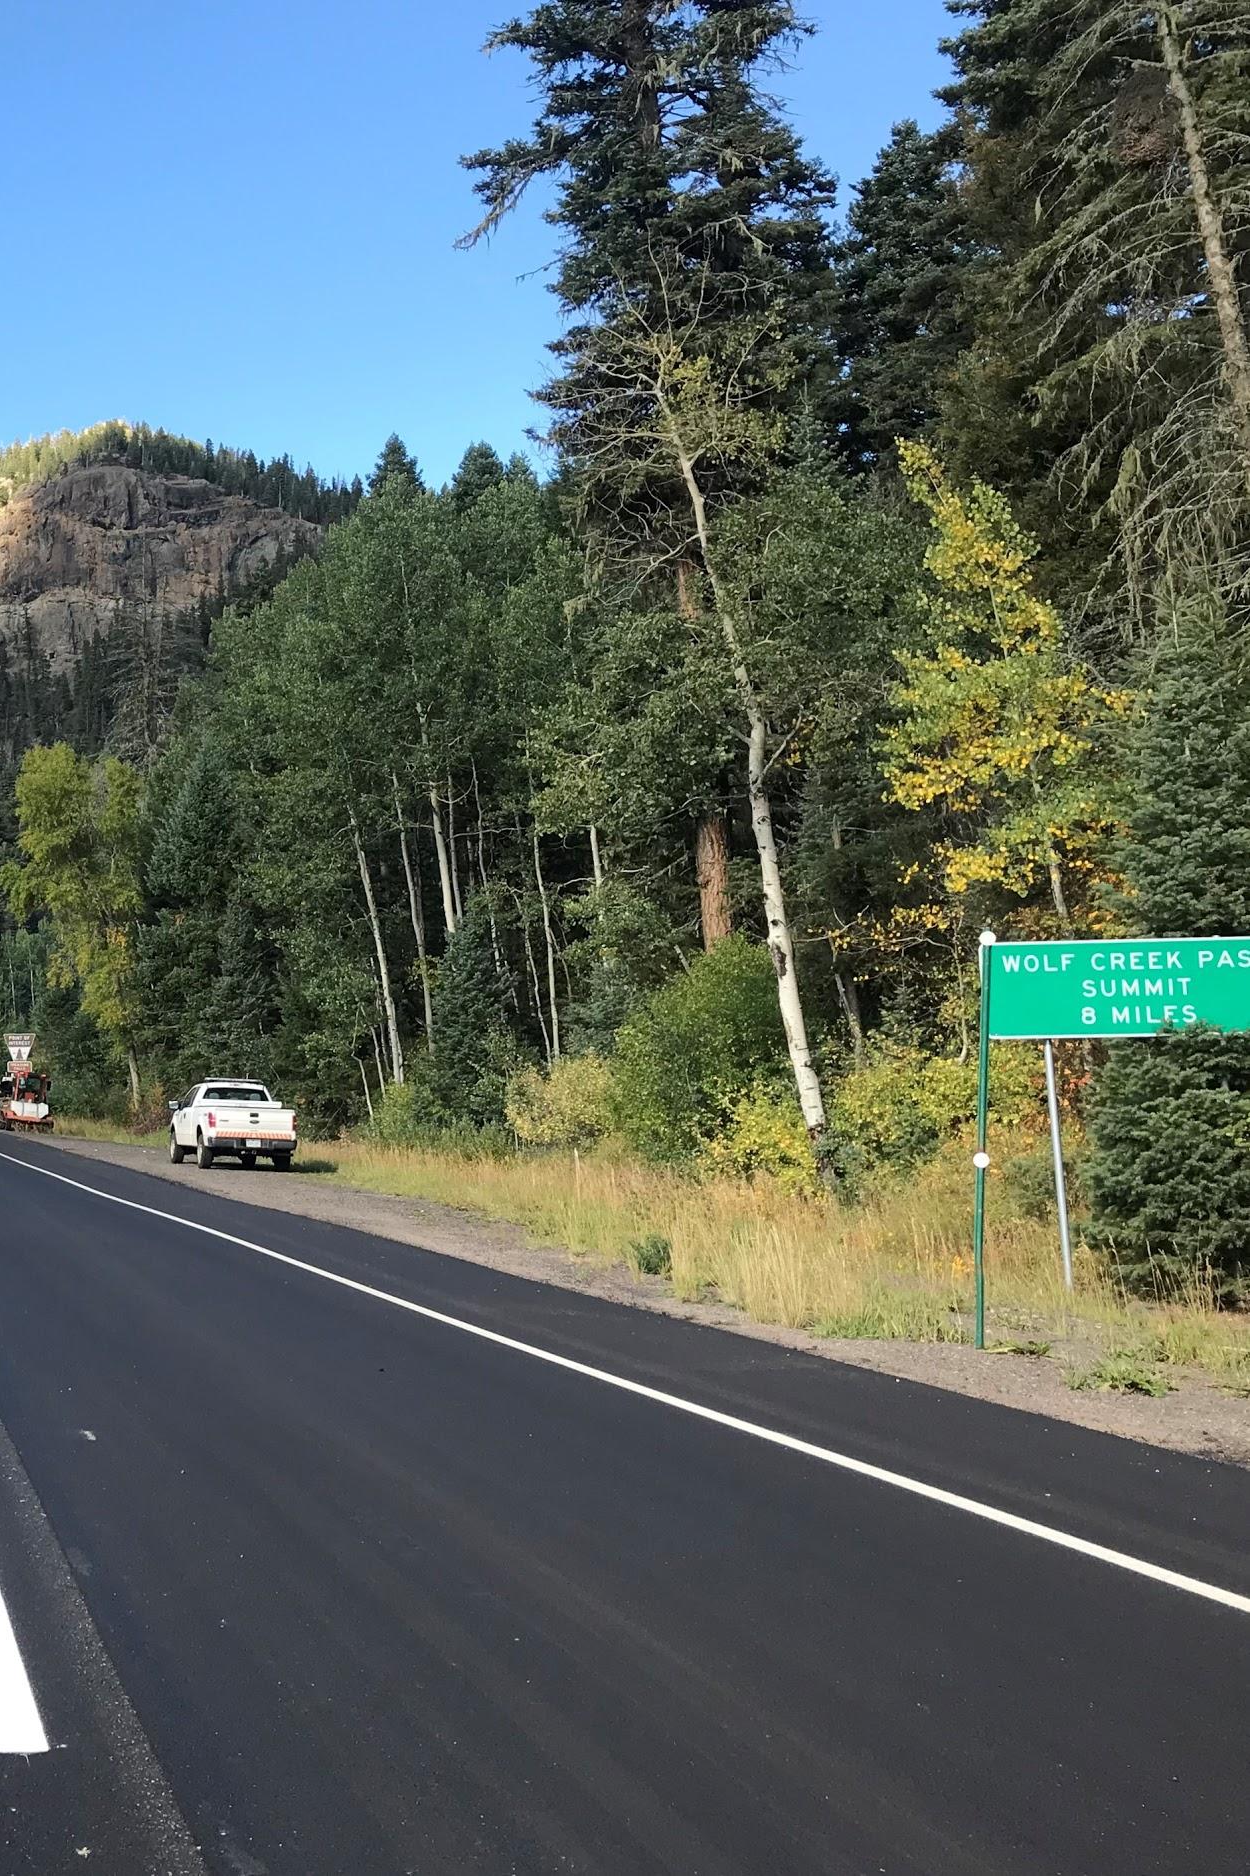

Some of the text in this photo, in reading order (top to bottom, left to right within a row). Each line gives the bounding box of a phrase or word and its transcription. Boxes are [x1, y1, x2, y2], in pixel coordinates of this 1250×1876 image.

[1002, 953, 1075, 973] WOLF
[1090, 951, 1183, 971] CREEK
[1082, 977, 1191, 998] SUMMIT
[1081, 1004, 1197, 1025] 8 MILES
